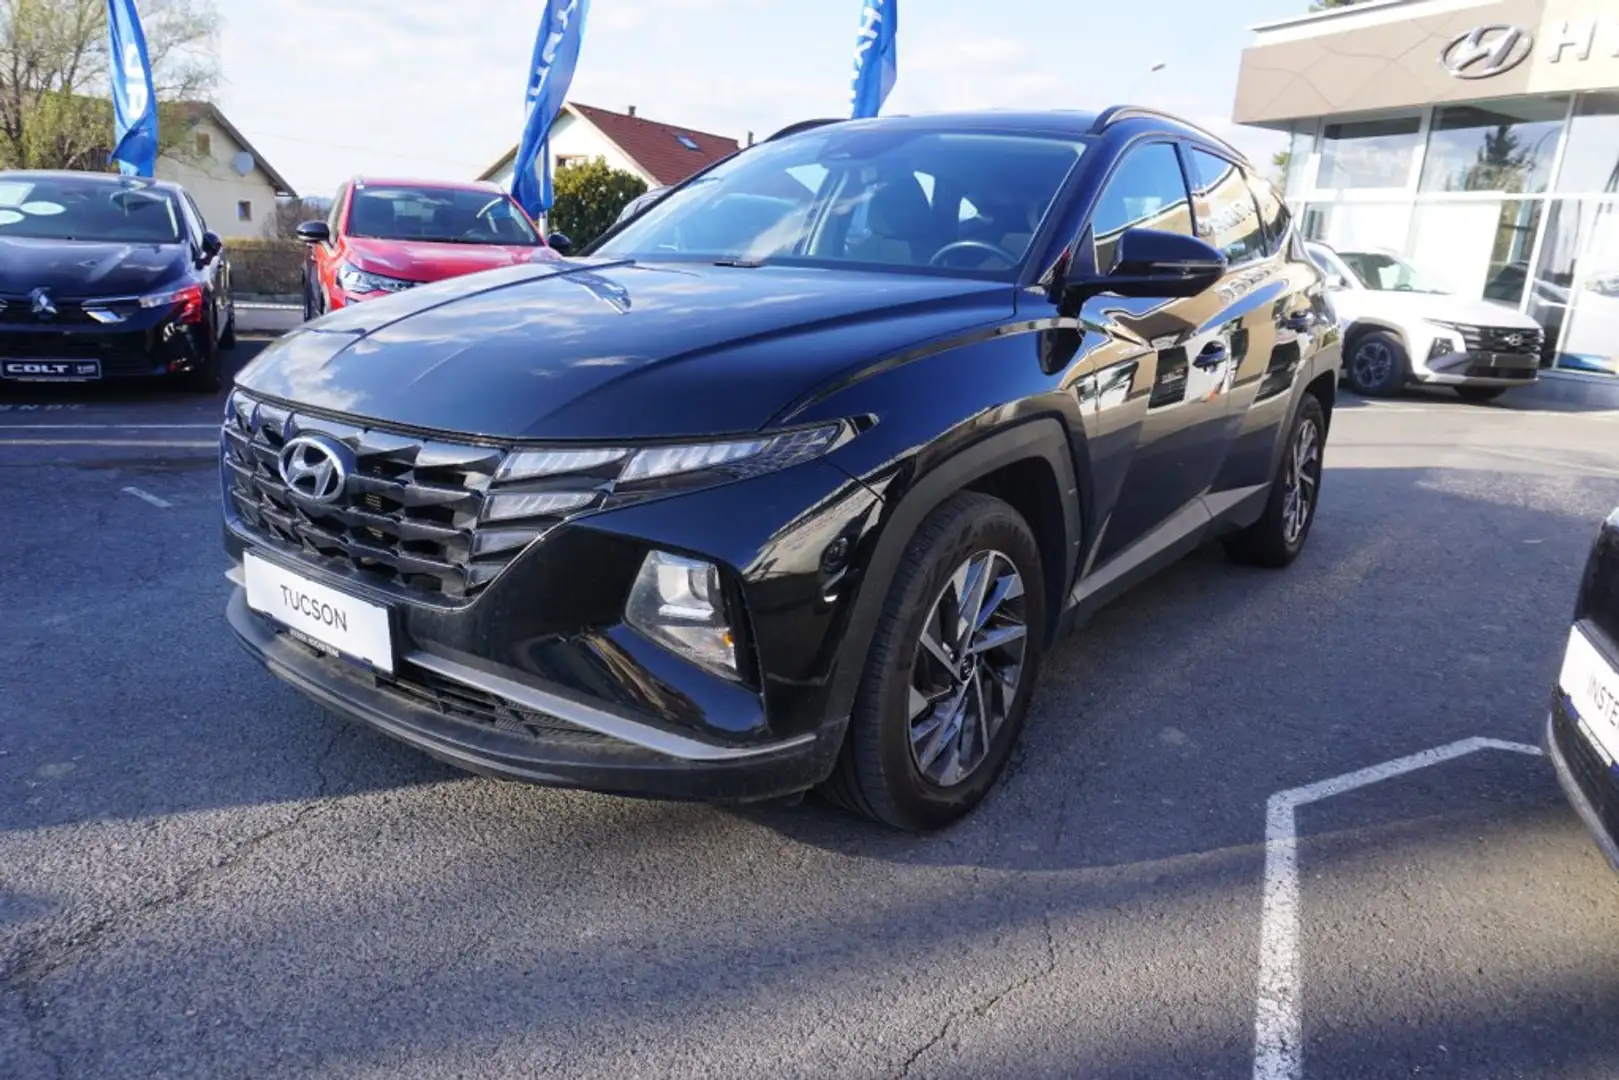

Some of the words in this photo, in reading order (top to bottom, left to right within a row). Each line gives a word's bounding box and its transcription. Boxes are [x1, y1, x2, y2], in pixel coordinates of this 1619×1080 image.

[6, 363, 69, 374] COLT
[280, 585, 348, 632] TUCSON
[1587, 669, 1619, 728] INSTE
